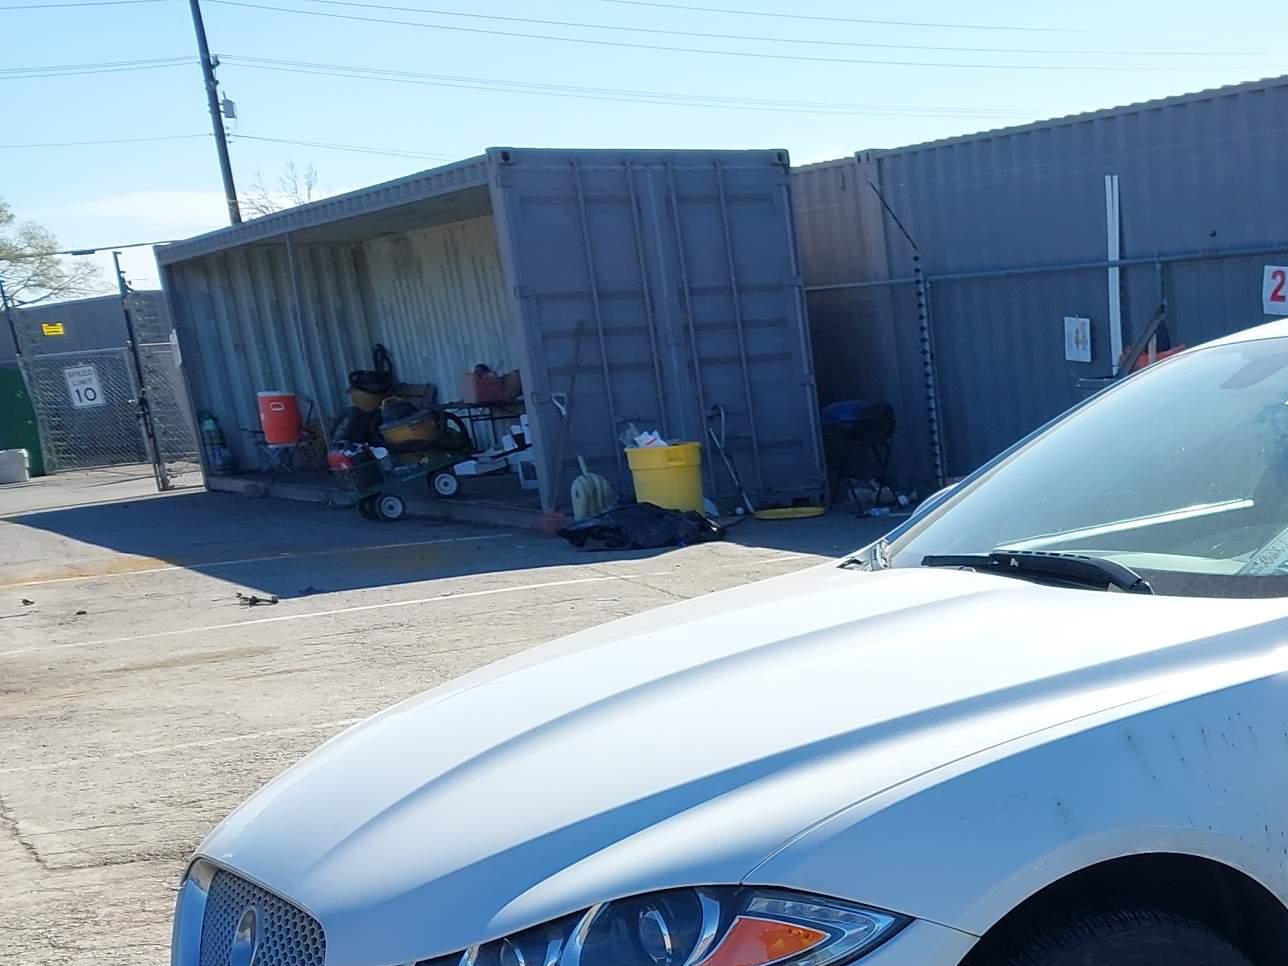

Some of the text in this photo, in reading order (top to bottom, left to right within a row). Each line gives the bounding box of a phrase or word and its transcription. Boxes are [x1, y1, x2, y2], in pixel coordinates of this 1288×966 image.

[1270, 270, 1286, 302] 2
[71, 378, 92, 386] LIMIT
[75, 387, 97, 403] 10
